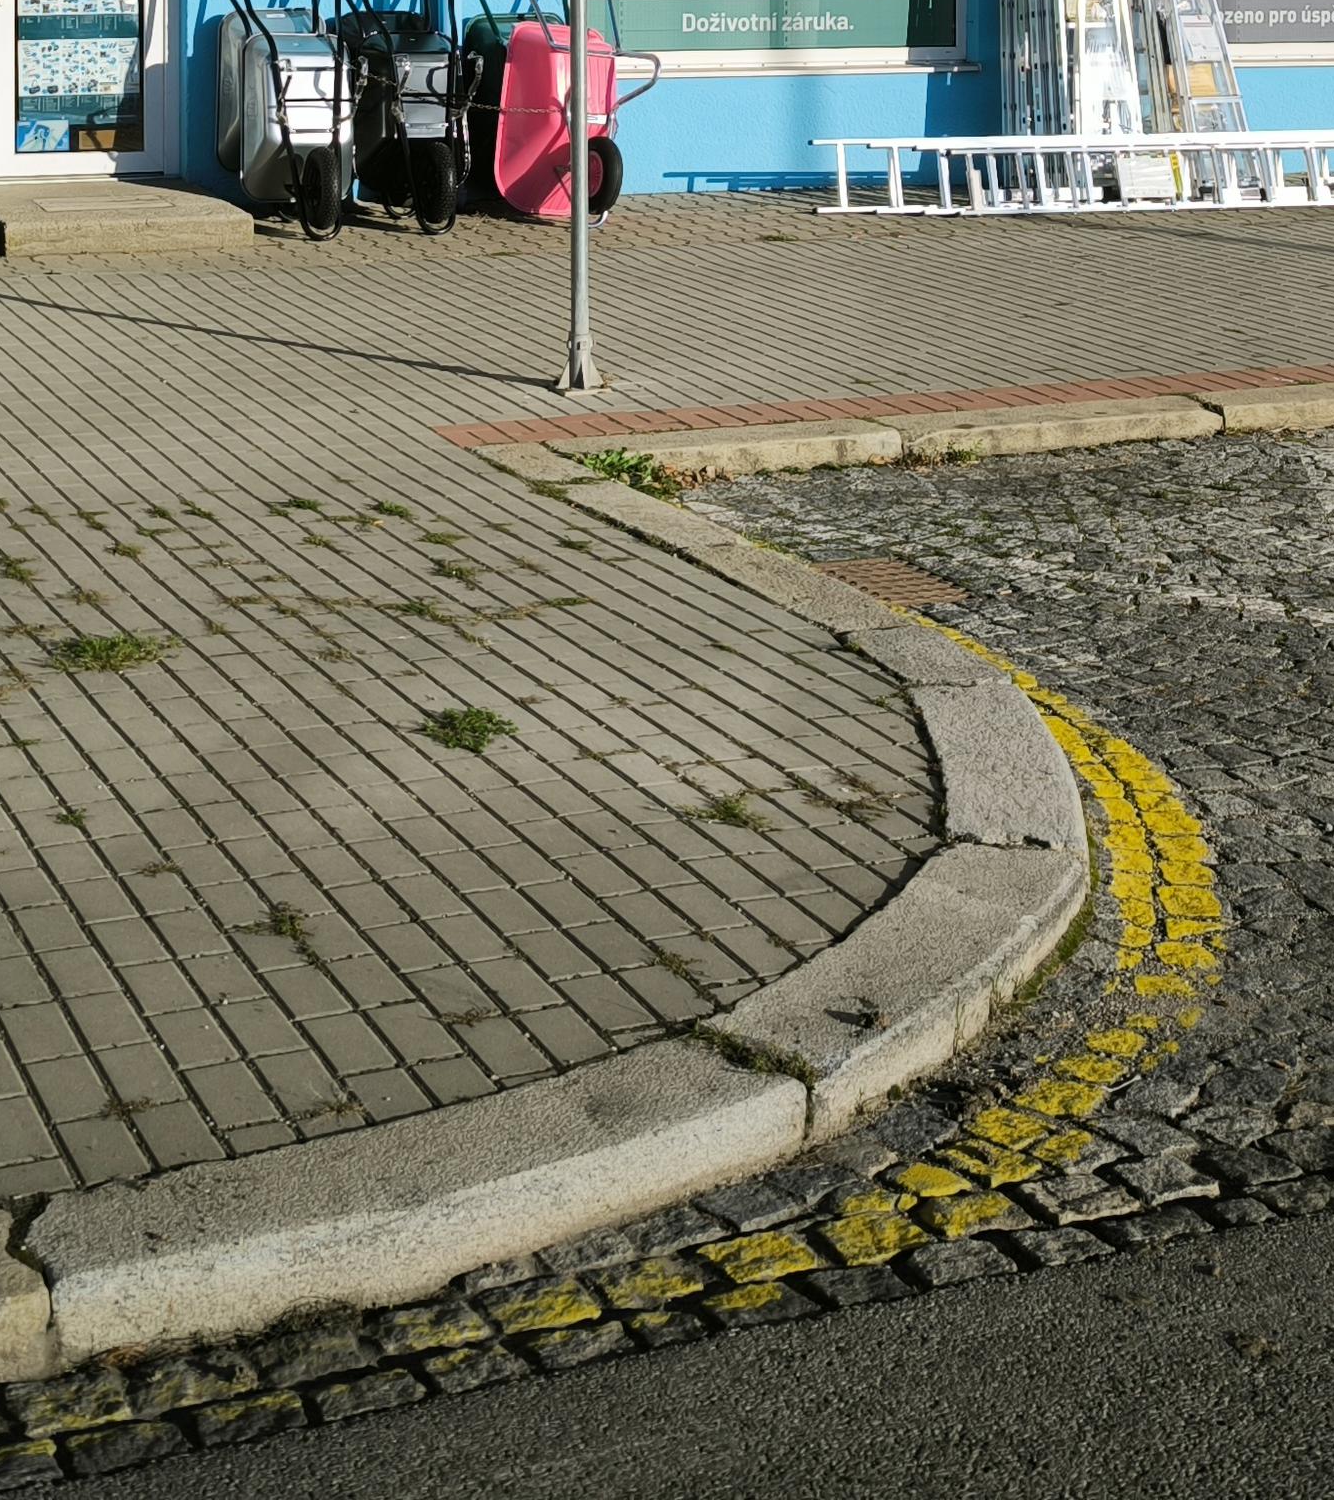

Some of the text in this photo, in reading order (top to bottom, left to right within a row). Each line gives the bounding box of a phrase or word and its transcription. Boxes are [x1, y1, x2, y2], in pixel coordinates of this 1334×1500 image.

[681, 11, 854, 33] Doživotní záruka.
[1269, 9, 1297, 27] pro
